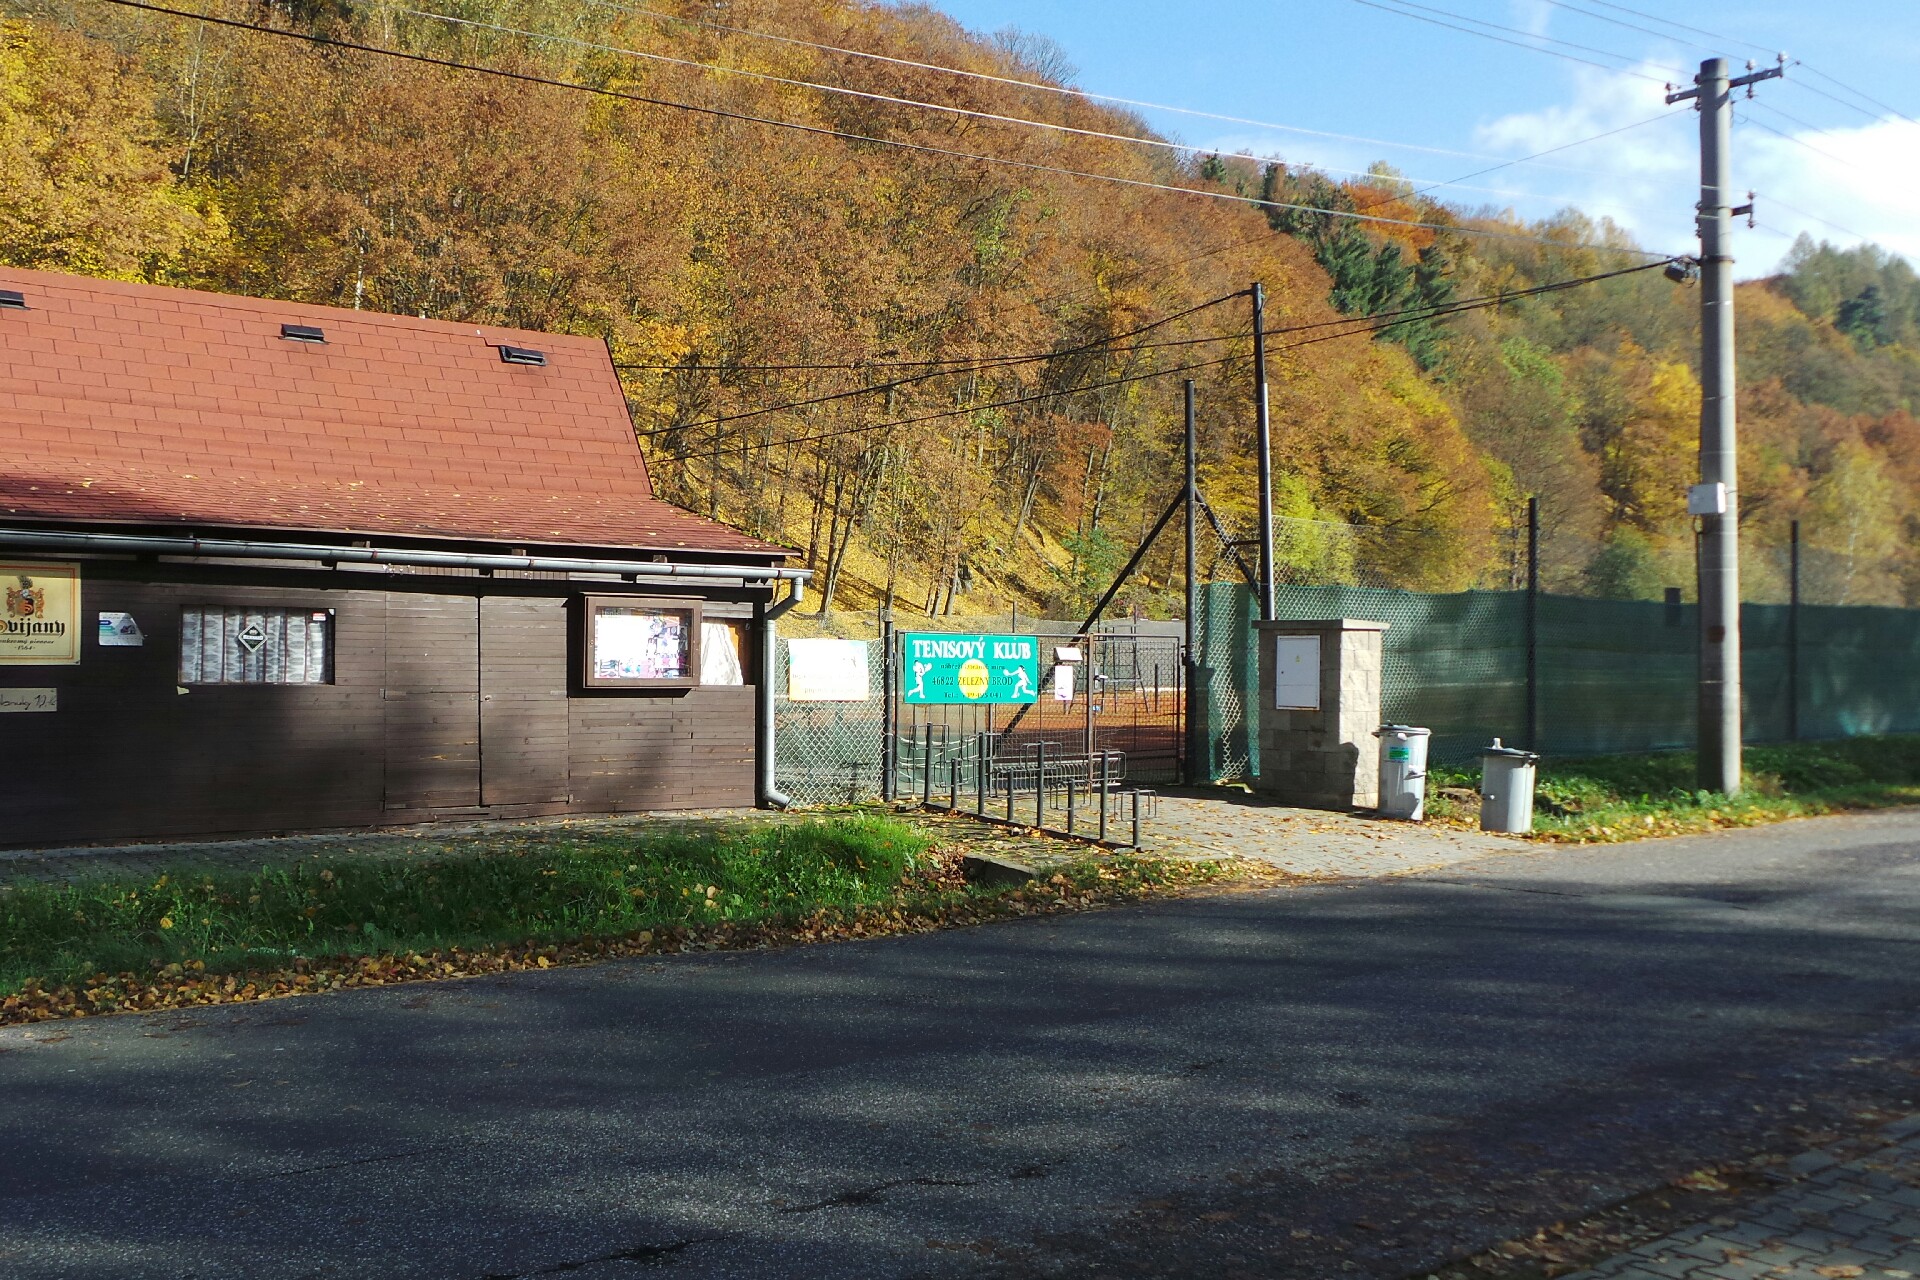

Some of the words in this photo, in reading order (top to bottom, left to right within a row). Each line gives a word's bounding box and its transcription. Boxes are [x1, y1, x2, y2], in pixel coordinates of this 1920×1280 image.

[912, 636, 985, 659] TENISOVÝ
[993, 642, 1031, 659] KLUB
[932, 676, 954, 686] 46822
[992, 676, 1014, 686] BROD
